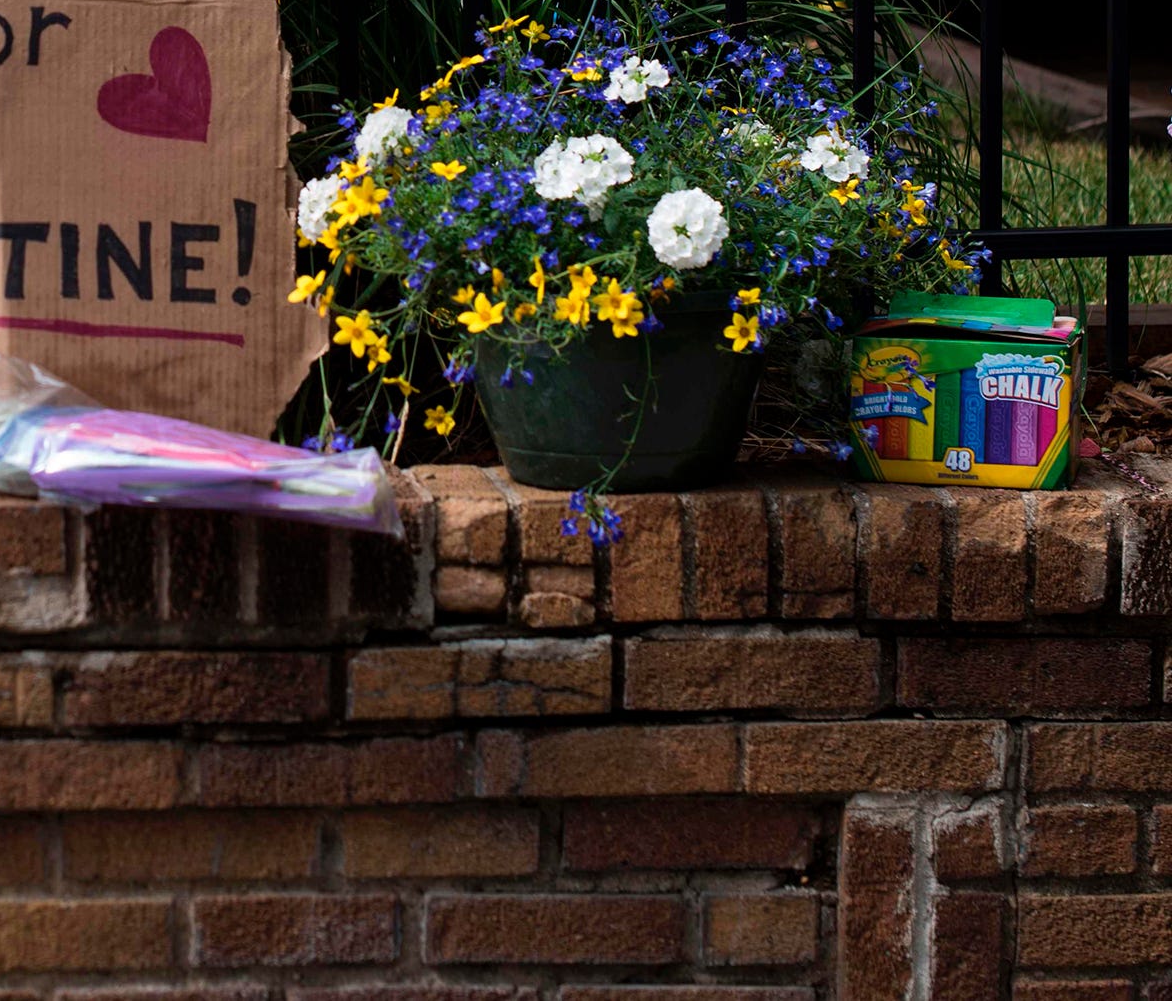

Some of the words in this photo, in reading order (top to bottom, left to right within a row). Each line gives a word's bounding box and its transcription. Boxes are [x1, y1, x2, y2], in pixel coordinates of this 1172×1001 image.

[988, 366, 1023, 375] Washable
[1023, 366, 1055, 375] Sidewalk
[981, 374, 1062, 406] CHALK
[945, 449, 972, 472] 48
